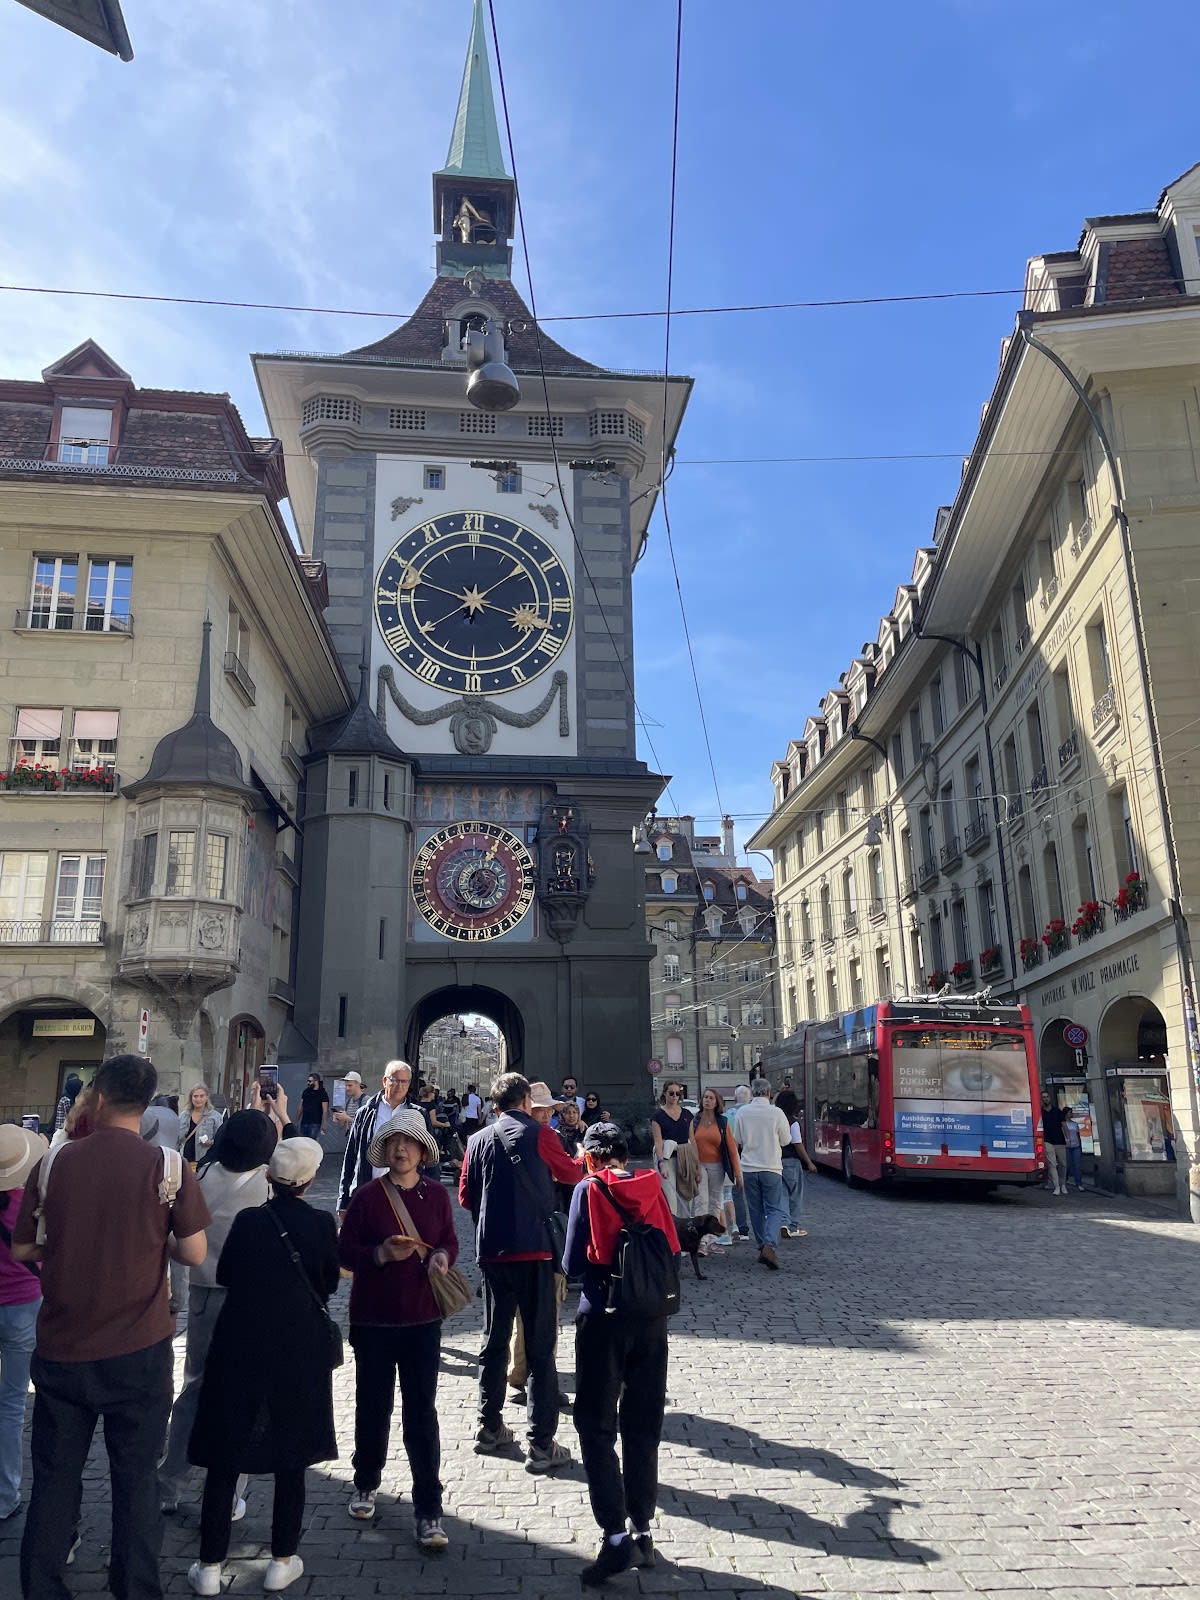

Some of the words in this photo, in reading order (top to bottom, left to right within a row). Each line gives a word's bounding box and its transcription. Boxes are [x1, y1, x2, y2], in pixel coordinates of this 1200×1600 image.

[462, 513, 485, 531] XII
[421, 523, 441, 543] XI
[512, 527, 523, 542] I
[540, 556, 559, 573] II
[378, 587, 397, 605] IX
[552, 597, 571, 612] III
[538, 633, 563, 657] IIII
[1100, 953, 1140, 984] PHARMACIE
[900, 1067, 927, 1075] DEINE
[900, 1077, 942, 1086] ZUKUNFT
[900, 1087, 912, 1095] IM
[901, 1115, 934, 1123] Ausbildung
[916, 1156, 929, 1165] 27
